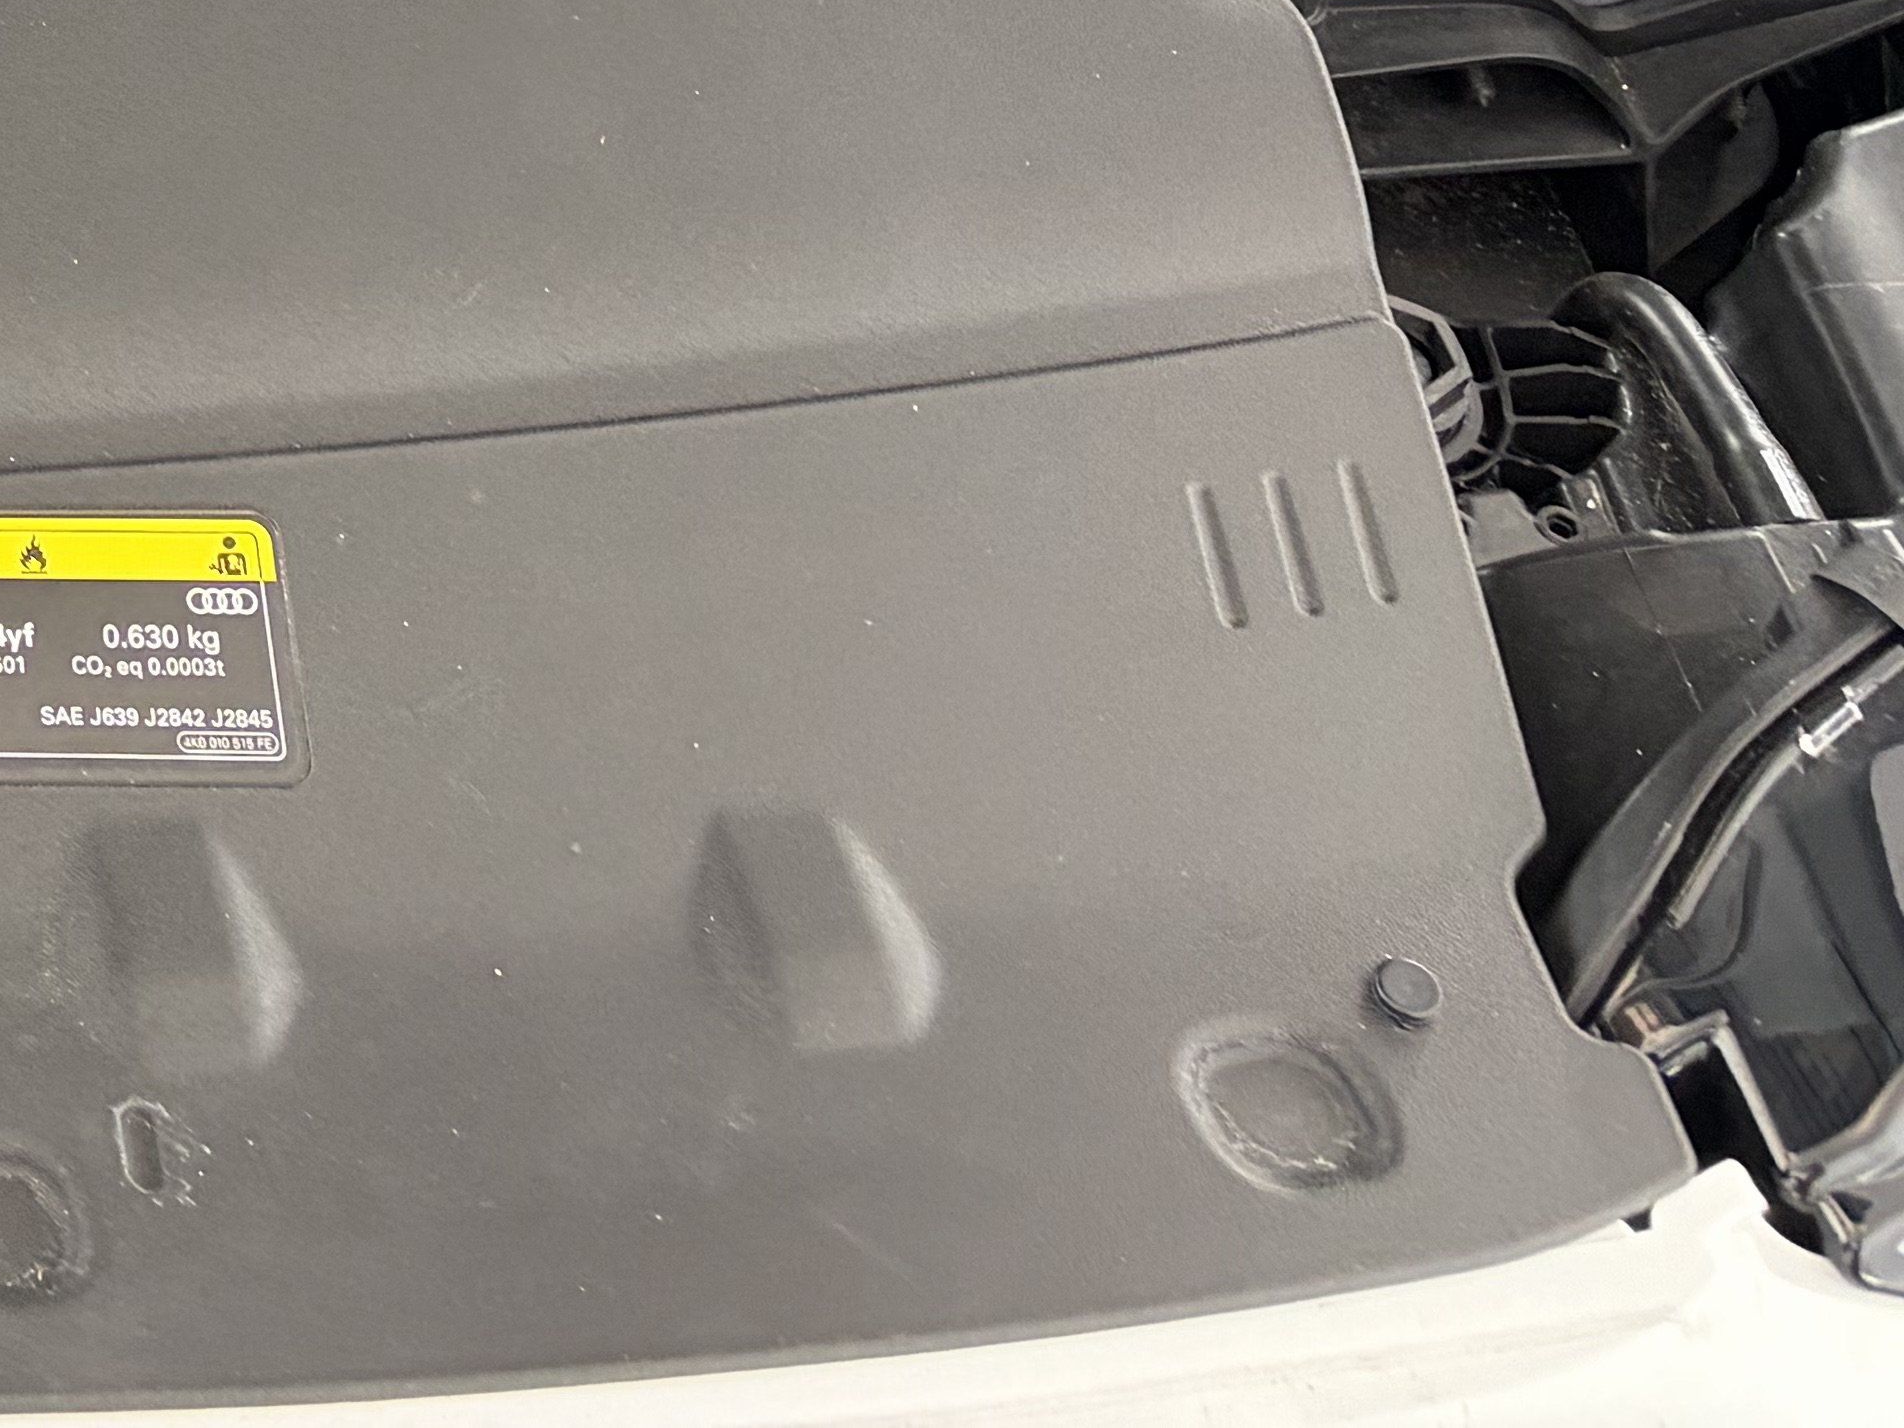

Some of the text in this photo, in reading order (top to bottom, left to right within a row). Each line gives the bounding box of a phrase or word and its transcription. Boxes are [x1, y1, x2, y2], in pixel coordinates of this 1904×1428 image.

[103, 624, 219, 655] 0.630 kg
[116, 661, 143, 679] eq
[148, 656, 225, 677] 0.0003t
[40, 706, 273, 728] SAE J639 J2842 J2845
[209, 737, 230, 749] 010
[257, 737, 273, 750] FE
